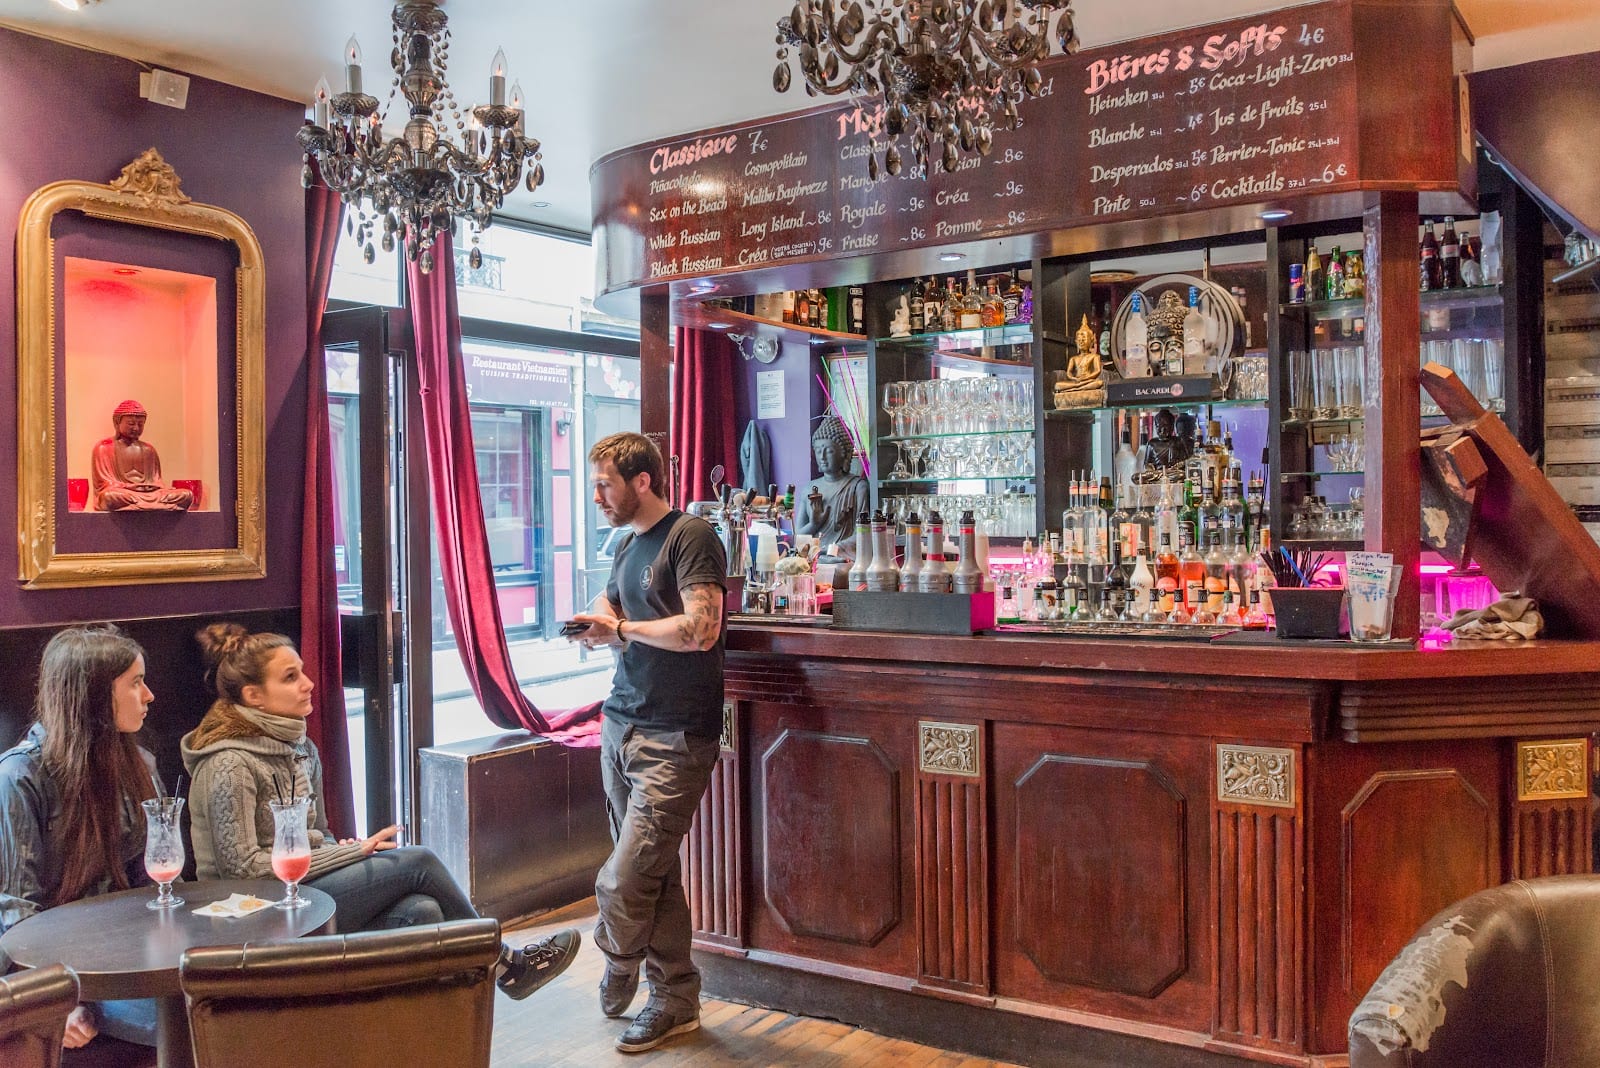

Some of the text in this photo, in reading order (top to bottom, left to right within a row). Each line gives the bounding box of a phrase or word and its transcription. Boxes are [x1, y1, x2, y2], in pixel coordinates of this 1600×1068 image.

[1200, 24, 1287, 71] Softs
[1299, 24, 1324, 46] 4€
[1089, 87, 1149, 115] Heineken
[1209, 107, 1235, 135] Jus
[1240, 104, 1257, 123] de
[1257, 95, 1305, 131] fruits
[748, 130, 769, 154] 7€
[1087, 122, 1145, 148] Blanche
[934, 156, 981, 175] Psion
[1090, 154, 1174, 187] Desperados
[935, 188, 970, 206] Créa
[1211, 170, 1286, 200] Cocktails
[649, 196, 728, 222] Sex on the Beach
[840, 199, 888, 229] Royale
[1093, 193, 1131, 216] Pinte
[740, 220, 767, 242] Long
[770, 210, 806, 233] Island
[935, 218, 983, 238] Pomme
[649, 228, 721, 251] White Russian
[840, 233, 879, 250] Fraise
[649, 255, 722, 279] Black Russian
[738, 246, 769, 266] Créa
[472, 356, 567, 376] Restaurant Vietnamien
[1135, 386, 1171, 396] BACARDI
